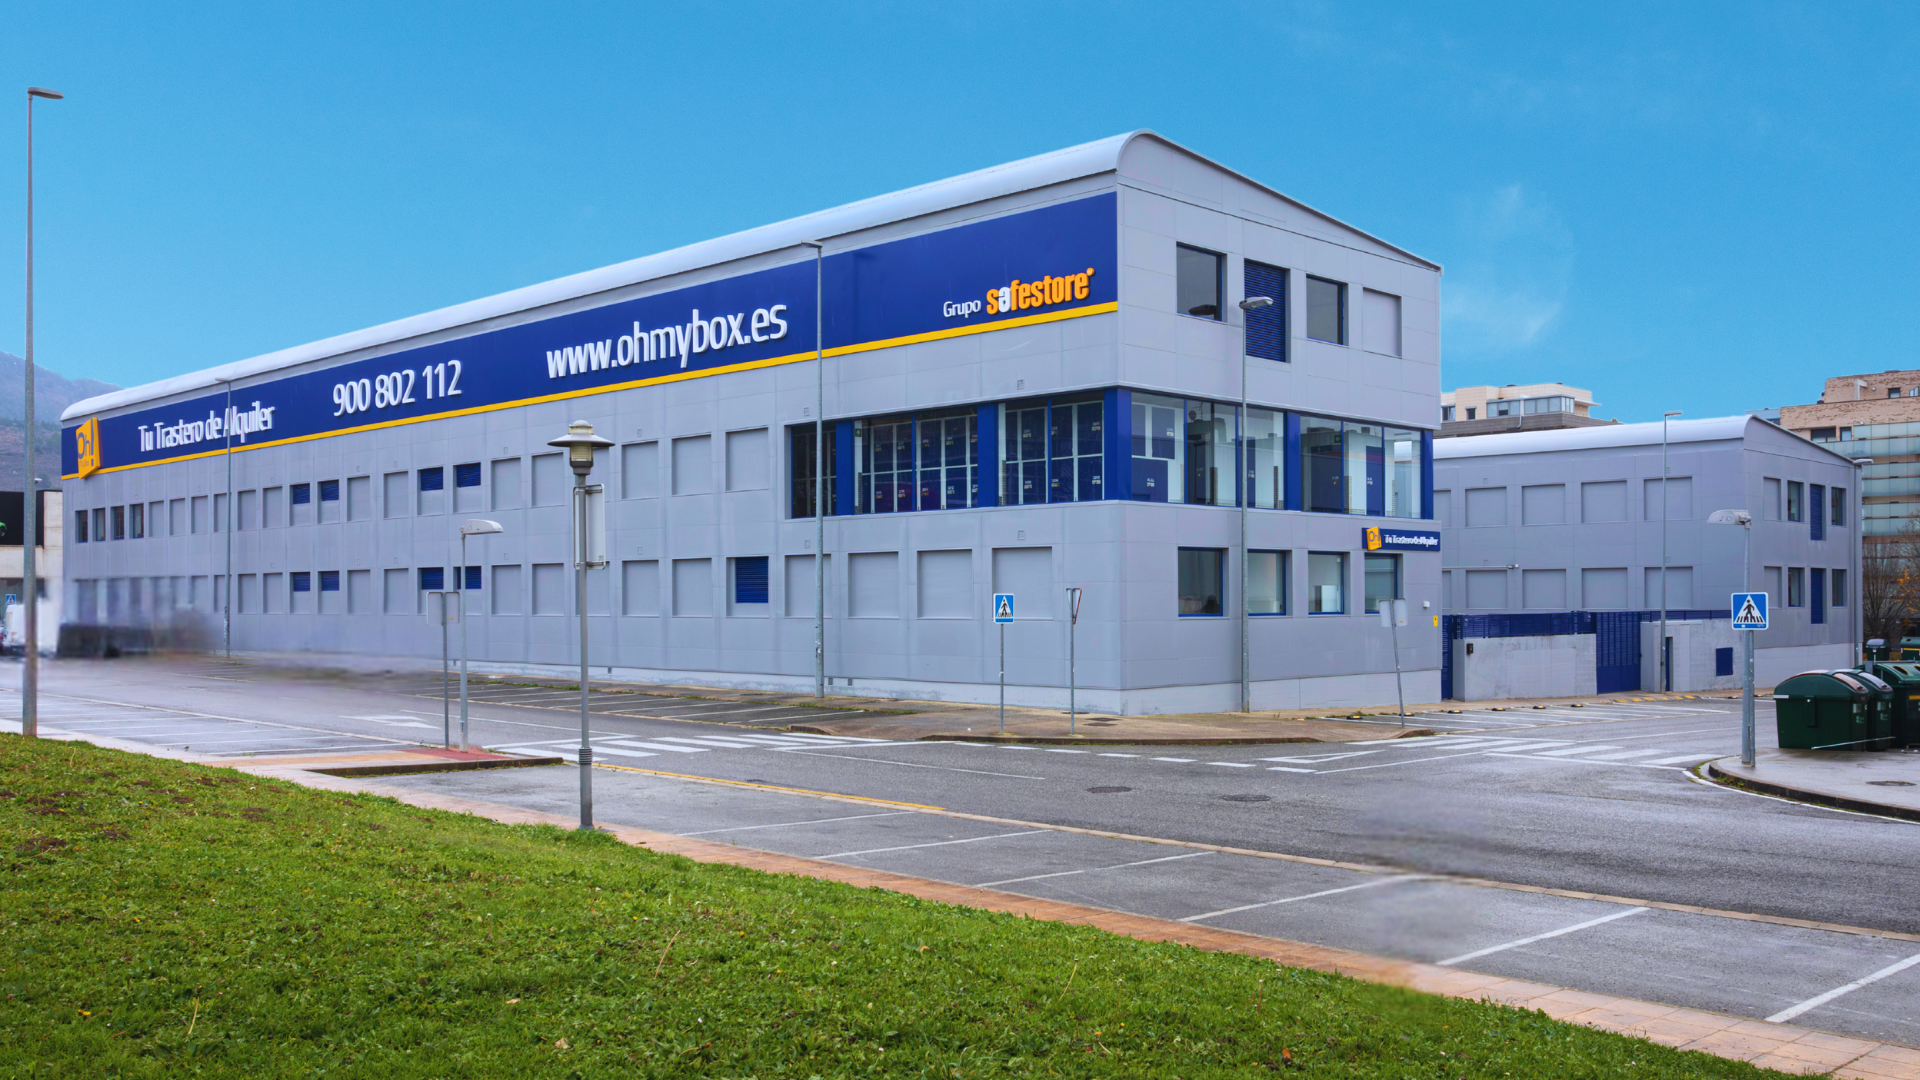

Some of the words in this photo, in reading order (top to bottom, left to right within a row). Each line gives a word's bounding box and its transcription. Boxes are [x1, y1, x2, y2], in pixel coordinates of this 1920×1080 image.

[943, 300, 982, 319] Grupo
[986, 267, 1095, 315] safestore
[546, 304, 788, 379] www.ohmybox.es
[333, 378, 371, 417] 900
[375, 369, 416, 409] 802
[422, 359, 462, 400] 112
[138, 425, 154, 452] Tu
[154, 421, 204, 450] Trastero
[205, 410, 222, 441] de
[223, 400, 275, 443] Alquiler
